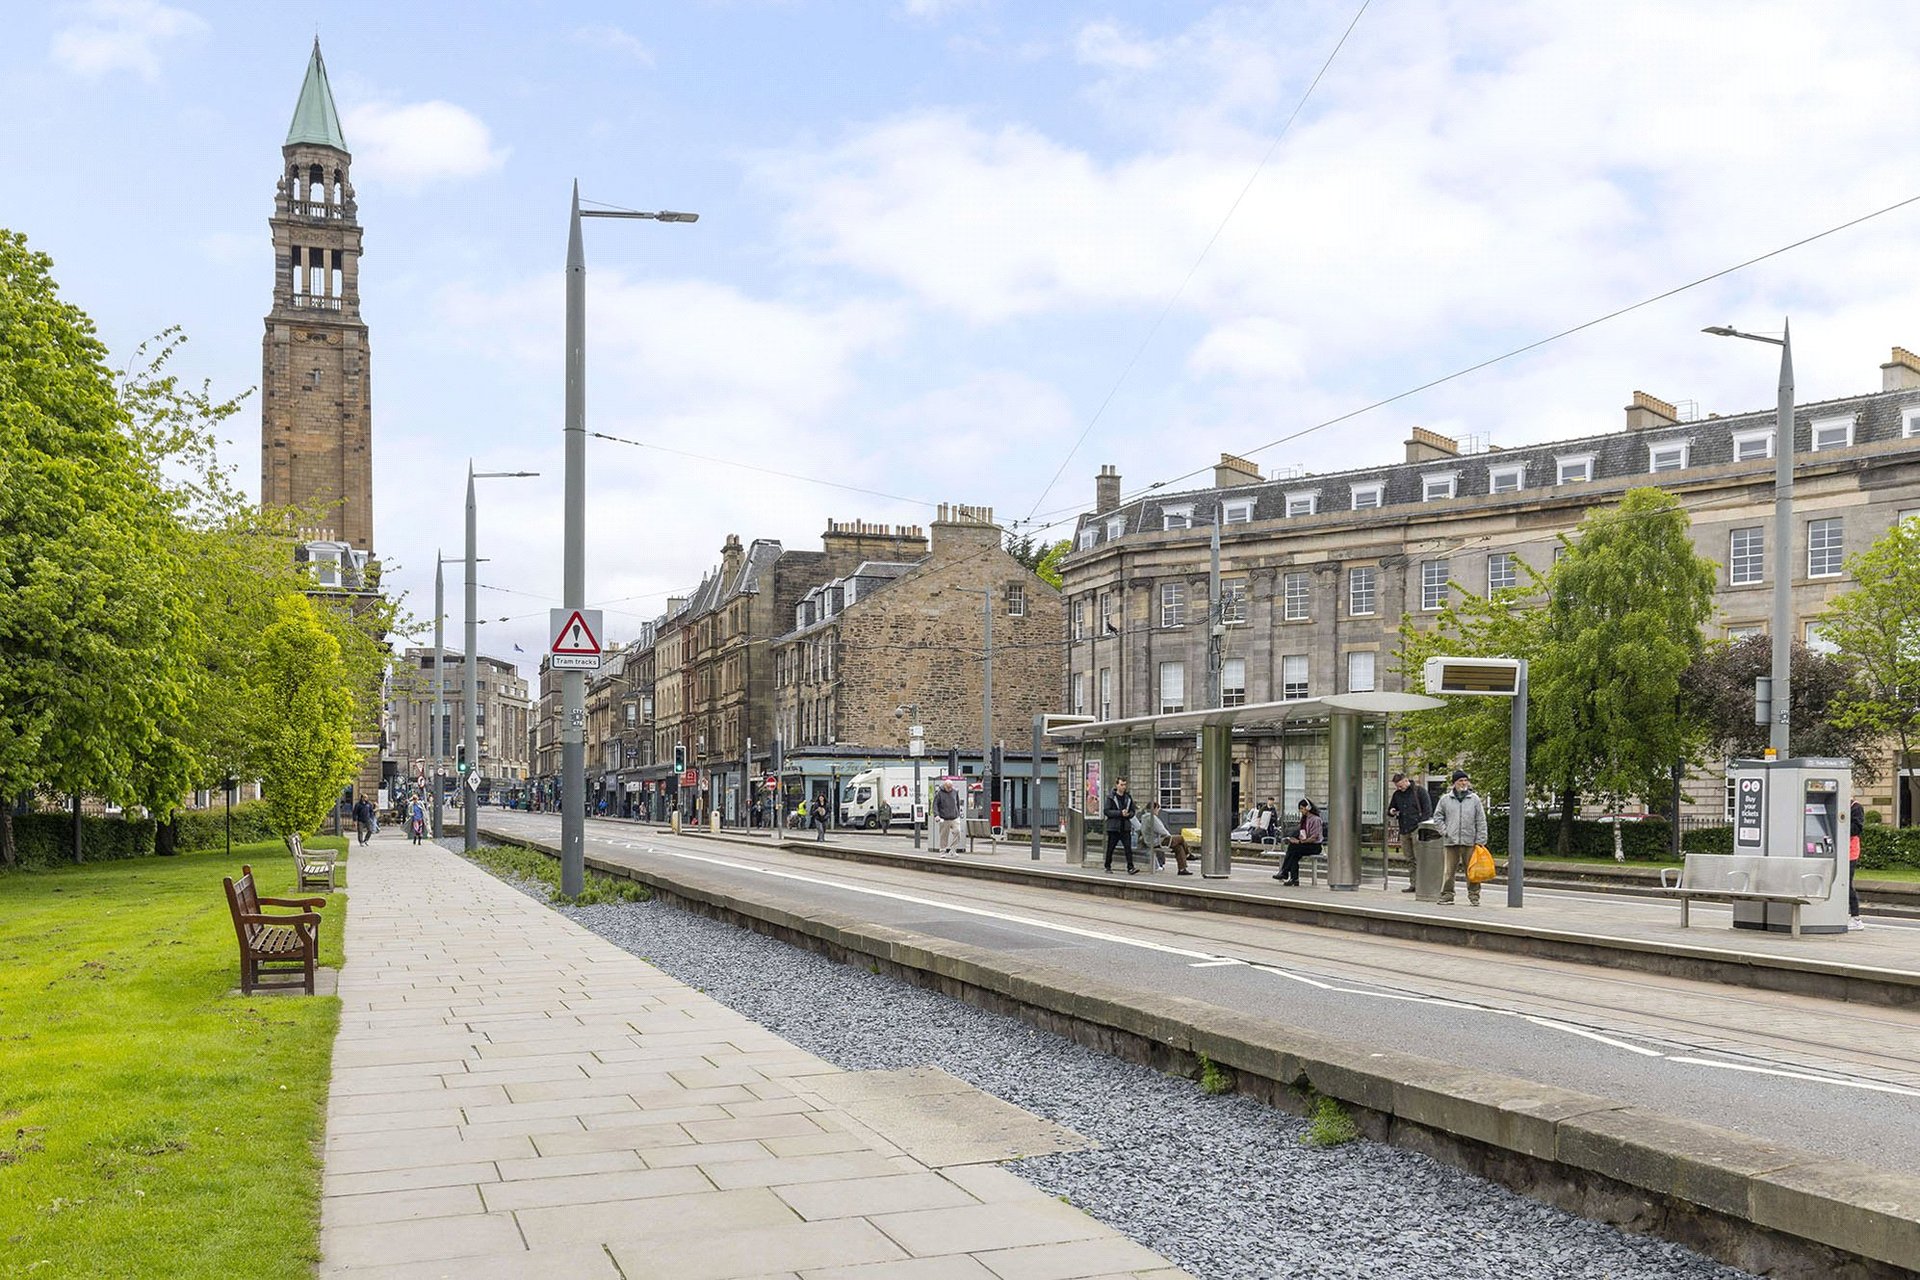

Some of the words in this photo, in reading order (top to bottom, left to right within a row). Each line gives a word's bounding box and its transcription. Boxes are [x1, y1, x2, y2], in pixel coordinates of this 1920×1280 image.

[556, 657, 574, 665] Tram
[575, 658, 597, 666] tracks
[470, 777, 479, 785] 15
[1745, 795, 1756, 803] Buy
[1744, 803, 1757, 811] your
[1743, 817, 1756, 825] here
